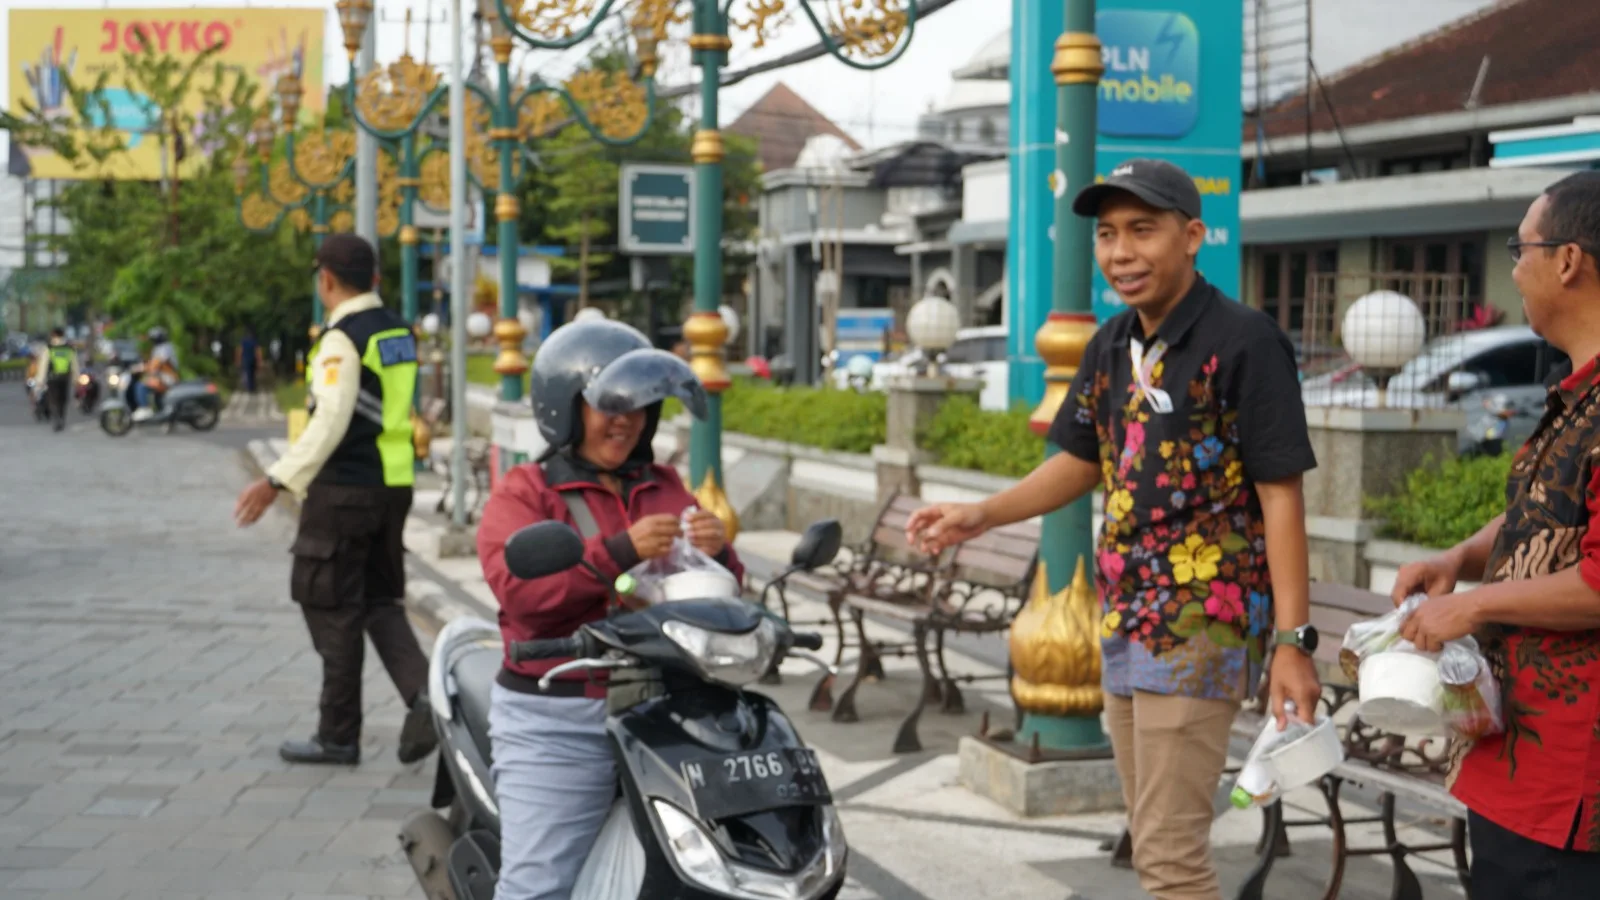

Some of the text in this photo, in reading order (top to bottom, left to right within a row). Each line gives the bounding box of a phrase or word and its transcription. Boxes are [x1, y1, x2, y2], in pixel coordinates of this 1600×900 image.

[100, 19, 232, 53] JOYKO
[1098, 73, 1193, 103] mobile
[724, 752, 784, 782] 2766
